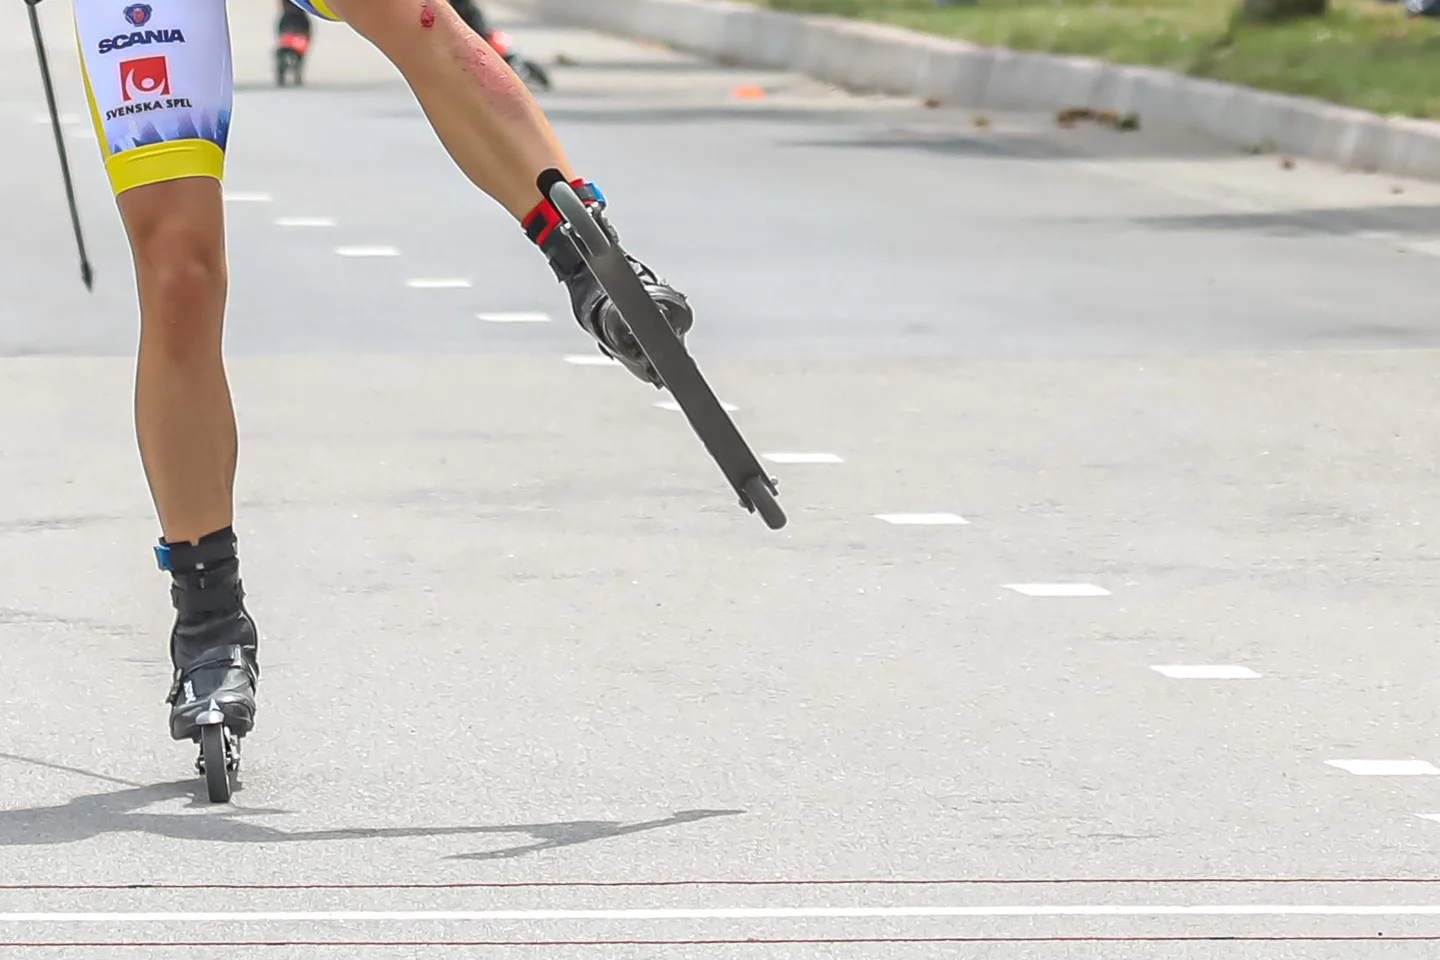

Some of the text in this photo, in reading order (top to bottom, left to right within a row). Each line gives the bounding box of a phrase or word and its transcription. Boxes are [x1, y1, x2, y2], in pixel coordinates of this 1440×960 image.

[98, 29, 186, 54] SCANIA
[105, 98, 192, 121] SVENSKA SPEL
